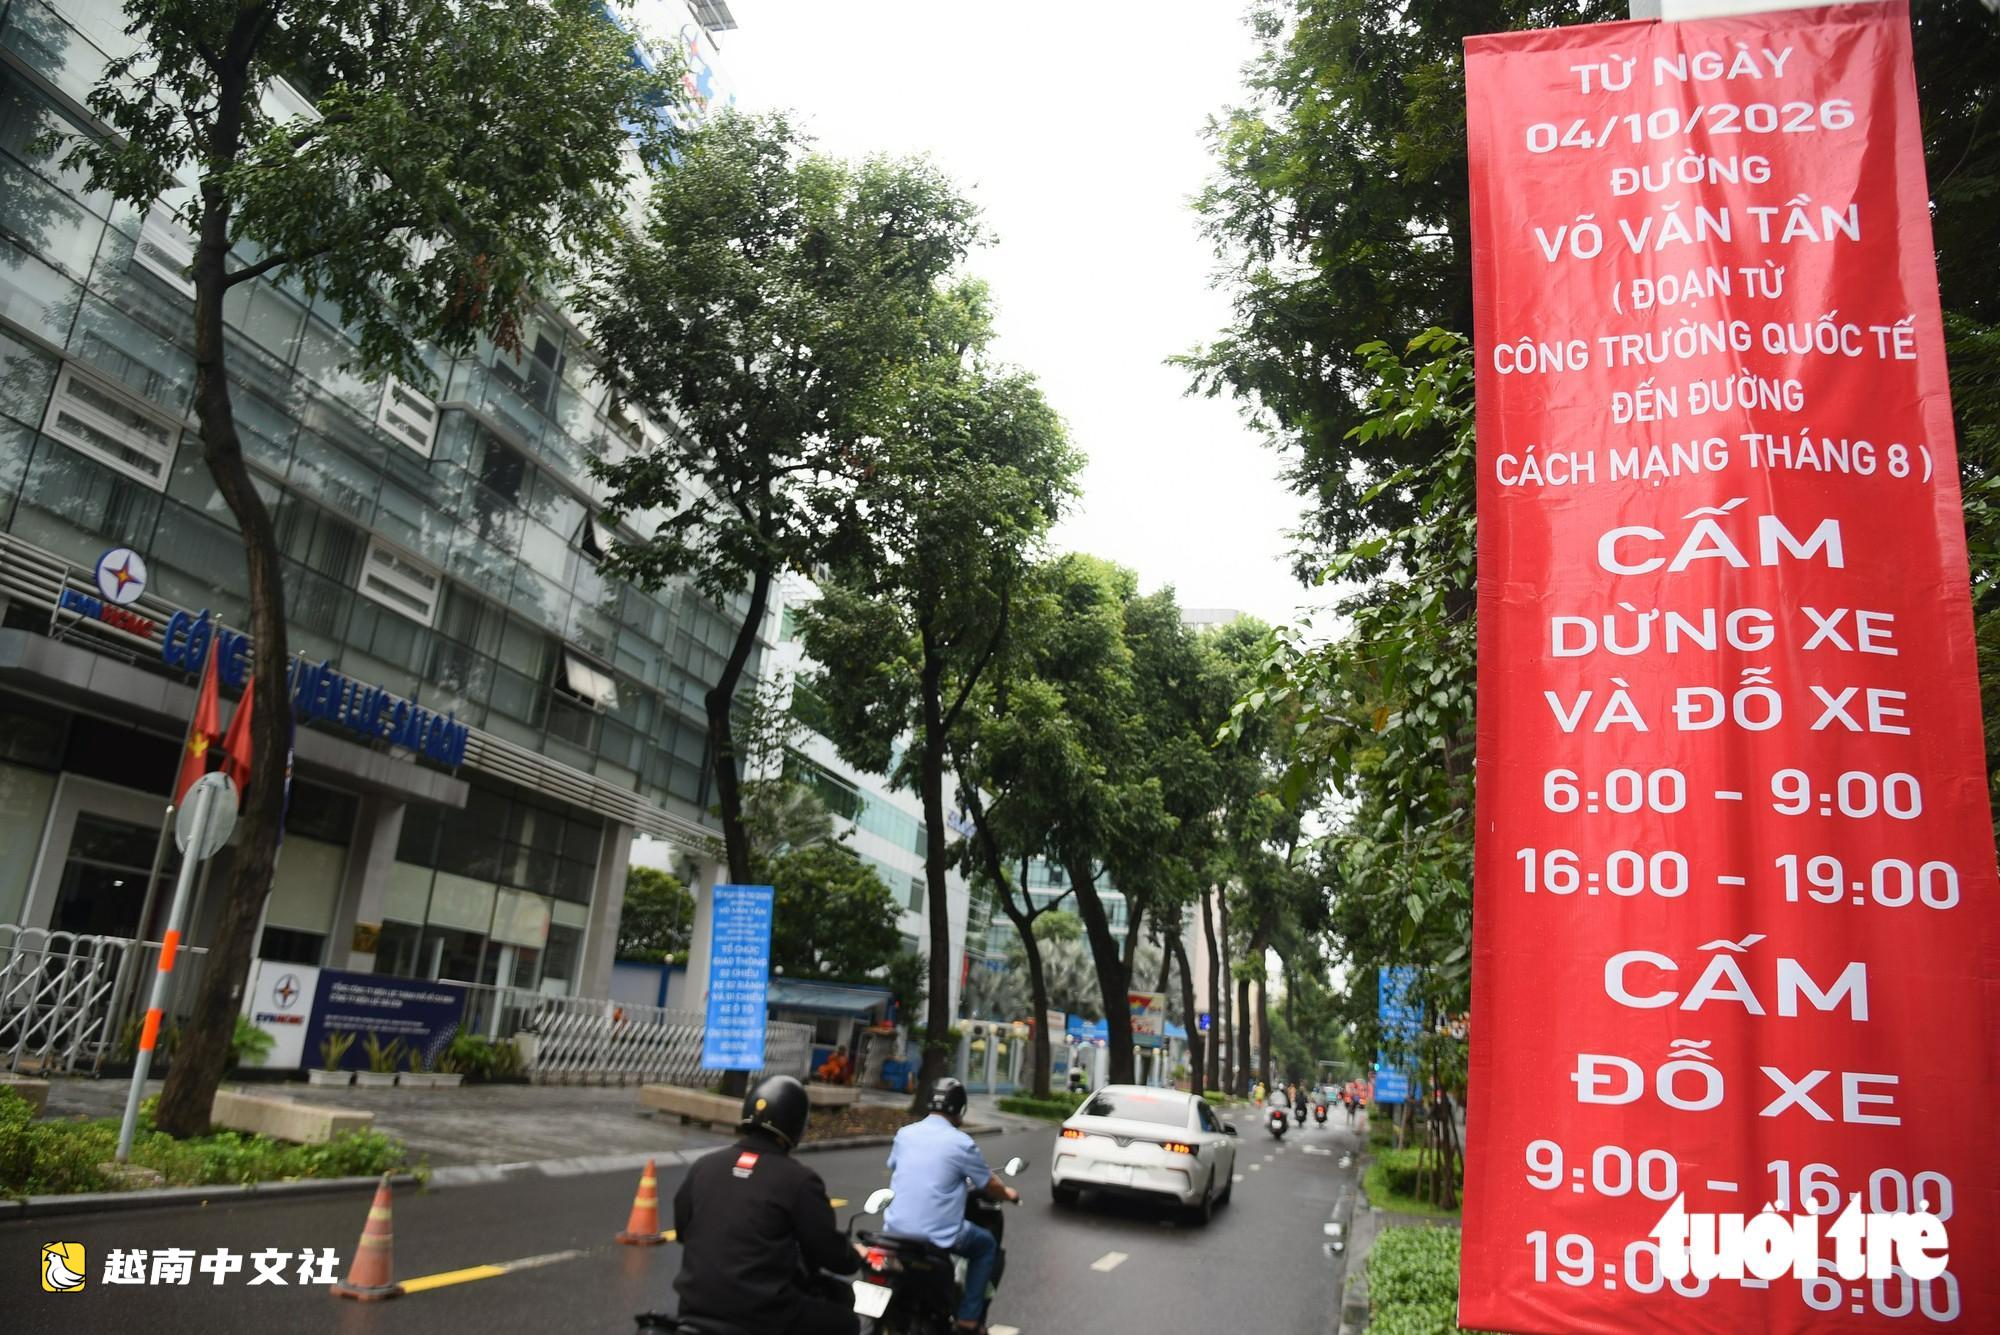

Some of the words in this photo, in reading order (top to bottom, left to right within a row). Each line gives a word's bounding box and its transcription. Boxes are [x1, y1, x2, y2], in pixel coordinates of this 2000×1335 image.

[1570, 53, 1637, 94] TỪ
[1653, 42, 1793, 87] NGÀY
[1526, 99, 1855, 153] 04/10/2026
[1609, 148, 1771, 197] ĐƯỜNG
[1534, 213, 1603, 262] VÕ
[1618, 201, 1731, 254] VĂN
[1746, 193, 1861, 244] TẦN
[1631, 266, 1731, 310] ĐOẠN
[1738, 259, 1785, 299] TỪ
[1493, 335, 1589, 375] CÔNG
[1598, 318, 1752, 368] TRƯỜNG
[1761, 309, 1864, 358] QUỐC
[1868, 314, 1917, 360] TẾ
[1611, 377, 1678, 424] ĐẾN
[1687, 367, 1805, 415] ĐƯỜNG
[1495, 444, 1595, 487] CÁCH
[1609, 437, 1729, 487] MẠNG
[1739, 427, 1877, 476] THÁNG
[1597, 497, 1845, 576] CẤM
[1551, 601, 1775, 658] DỪNG
[1800, 606, 1899, 657] XE
[1543, 677, 1649, 733] VÀ
[1671, 666, 1783, 732] ĐỖ
[1808, 685, 1911, 736] XE
[1543, 768, 1687, 814] 6:00
[1770, 768, 1923, 820] 9:00
[1516, 847, 1689, 898] 16:00
[1775, 854, 1960, 910] 19:00
[1604, 933, 1869, 1022] CẤM
[1570, 1038, 1725, 1112] ĐỖ
[1758, 1066, 1902, 1126] XE
[1525, 1139, 1678, 1201] 9:00
